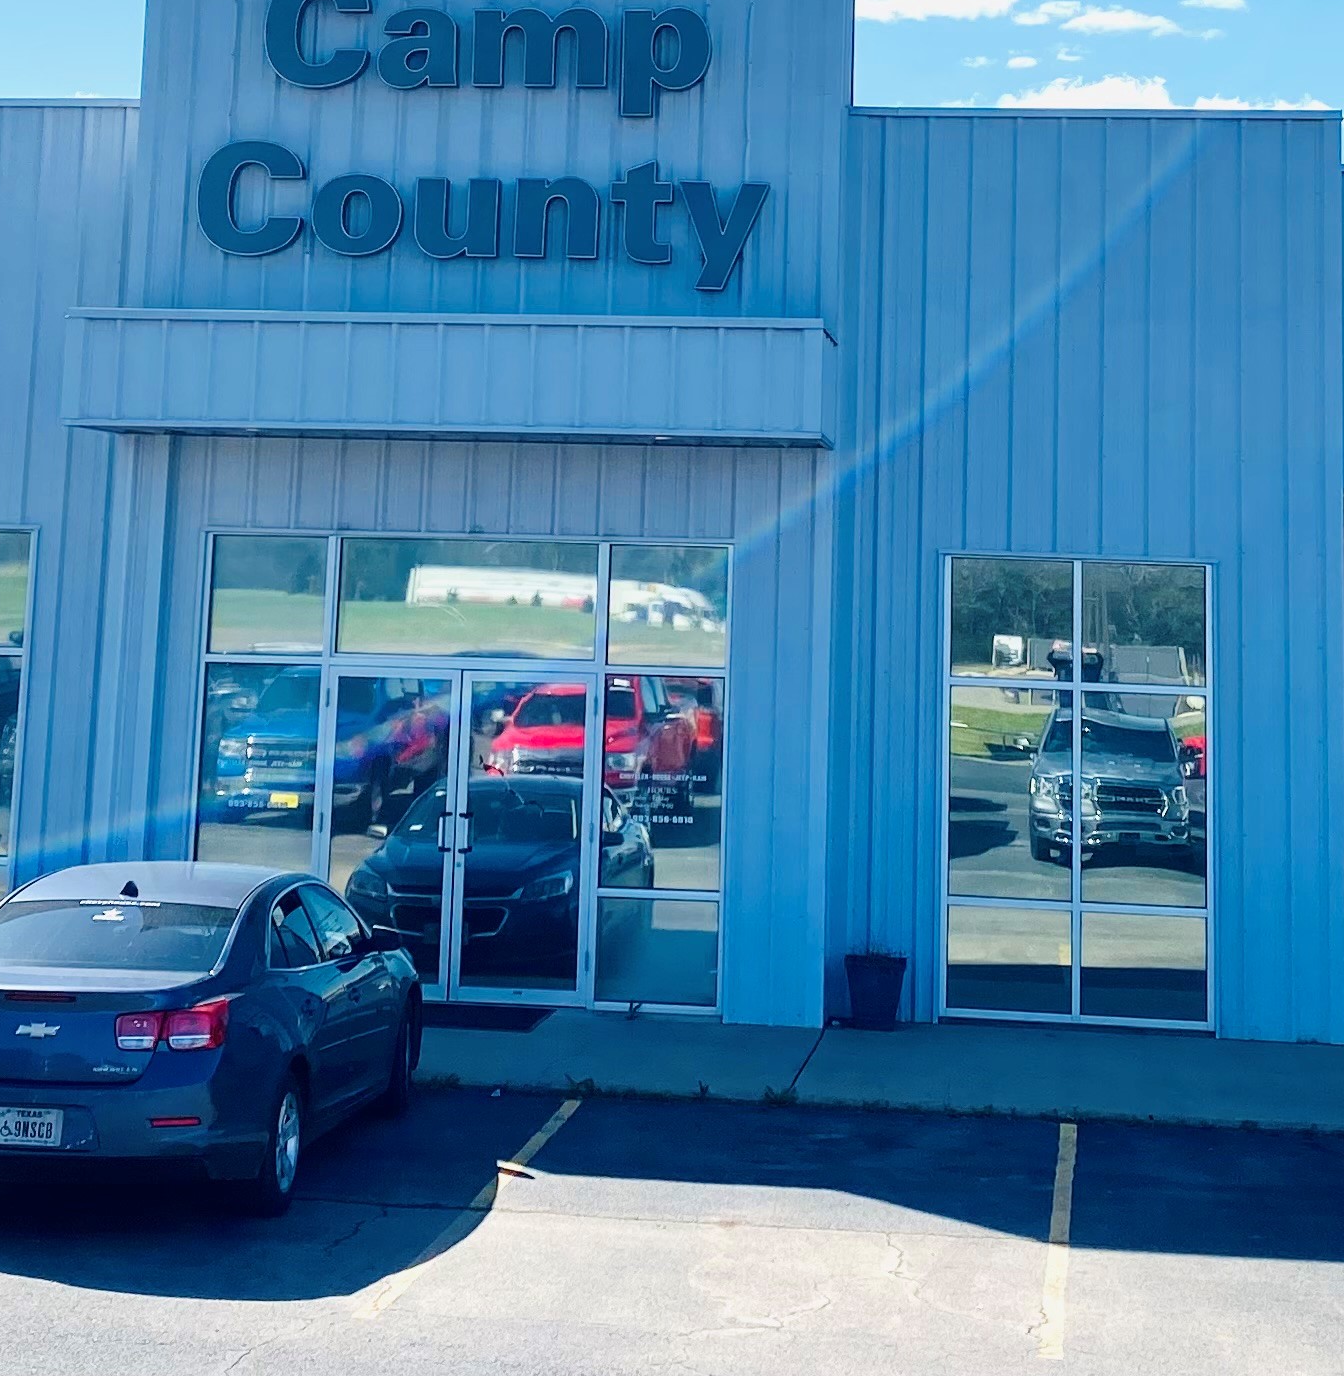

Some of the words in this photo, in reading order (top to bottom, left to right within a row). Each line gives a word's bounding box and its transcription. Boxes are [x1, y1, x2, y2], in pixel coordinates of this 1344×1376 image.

[196, 139, 771, 291] County
[17, 1109, 43, 1118] TEXAS
[14, 1120, 53, 1139] 9NSCB
